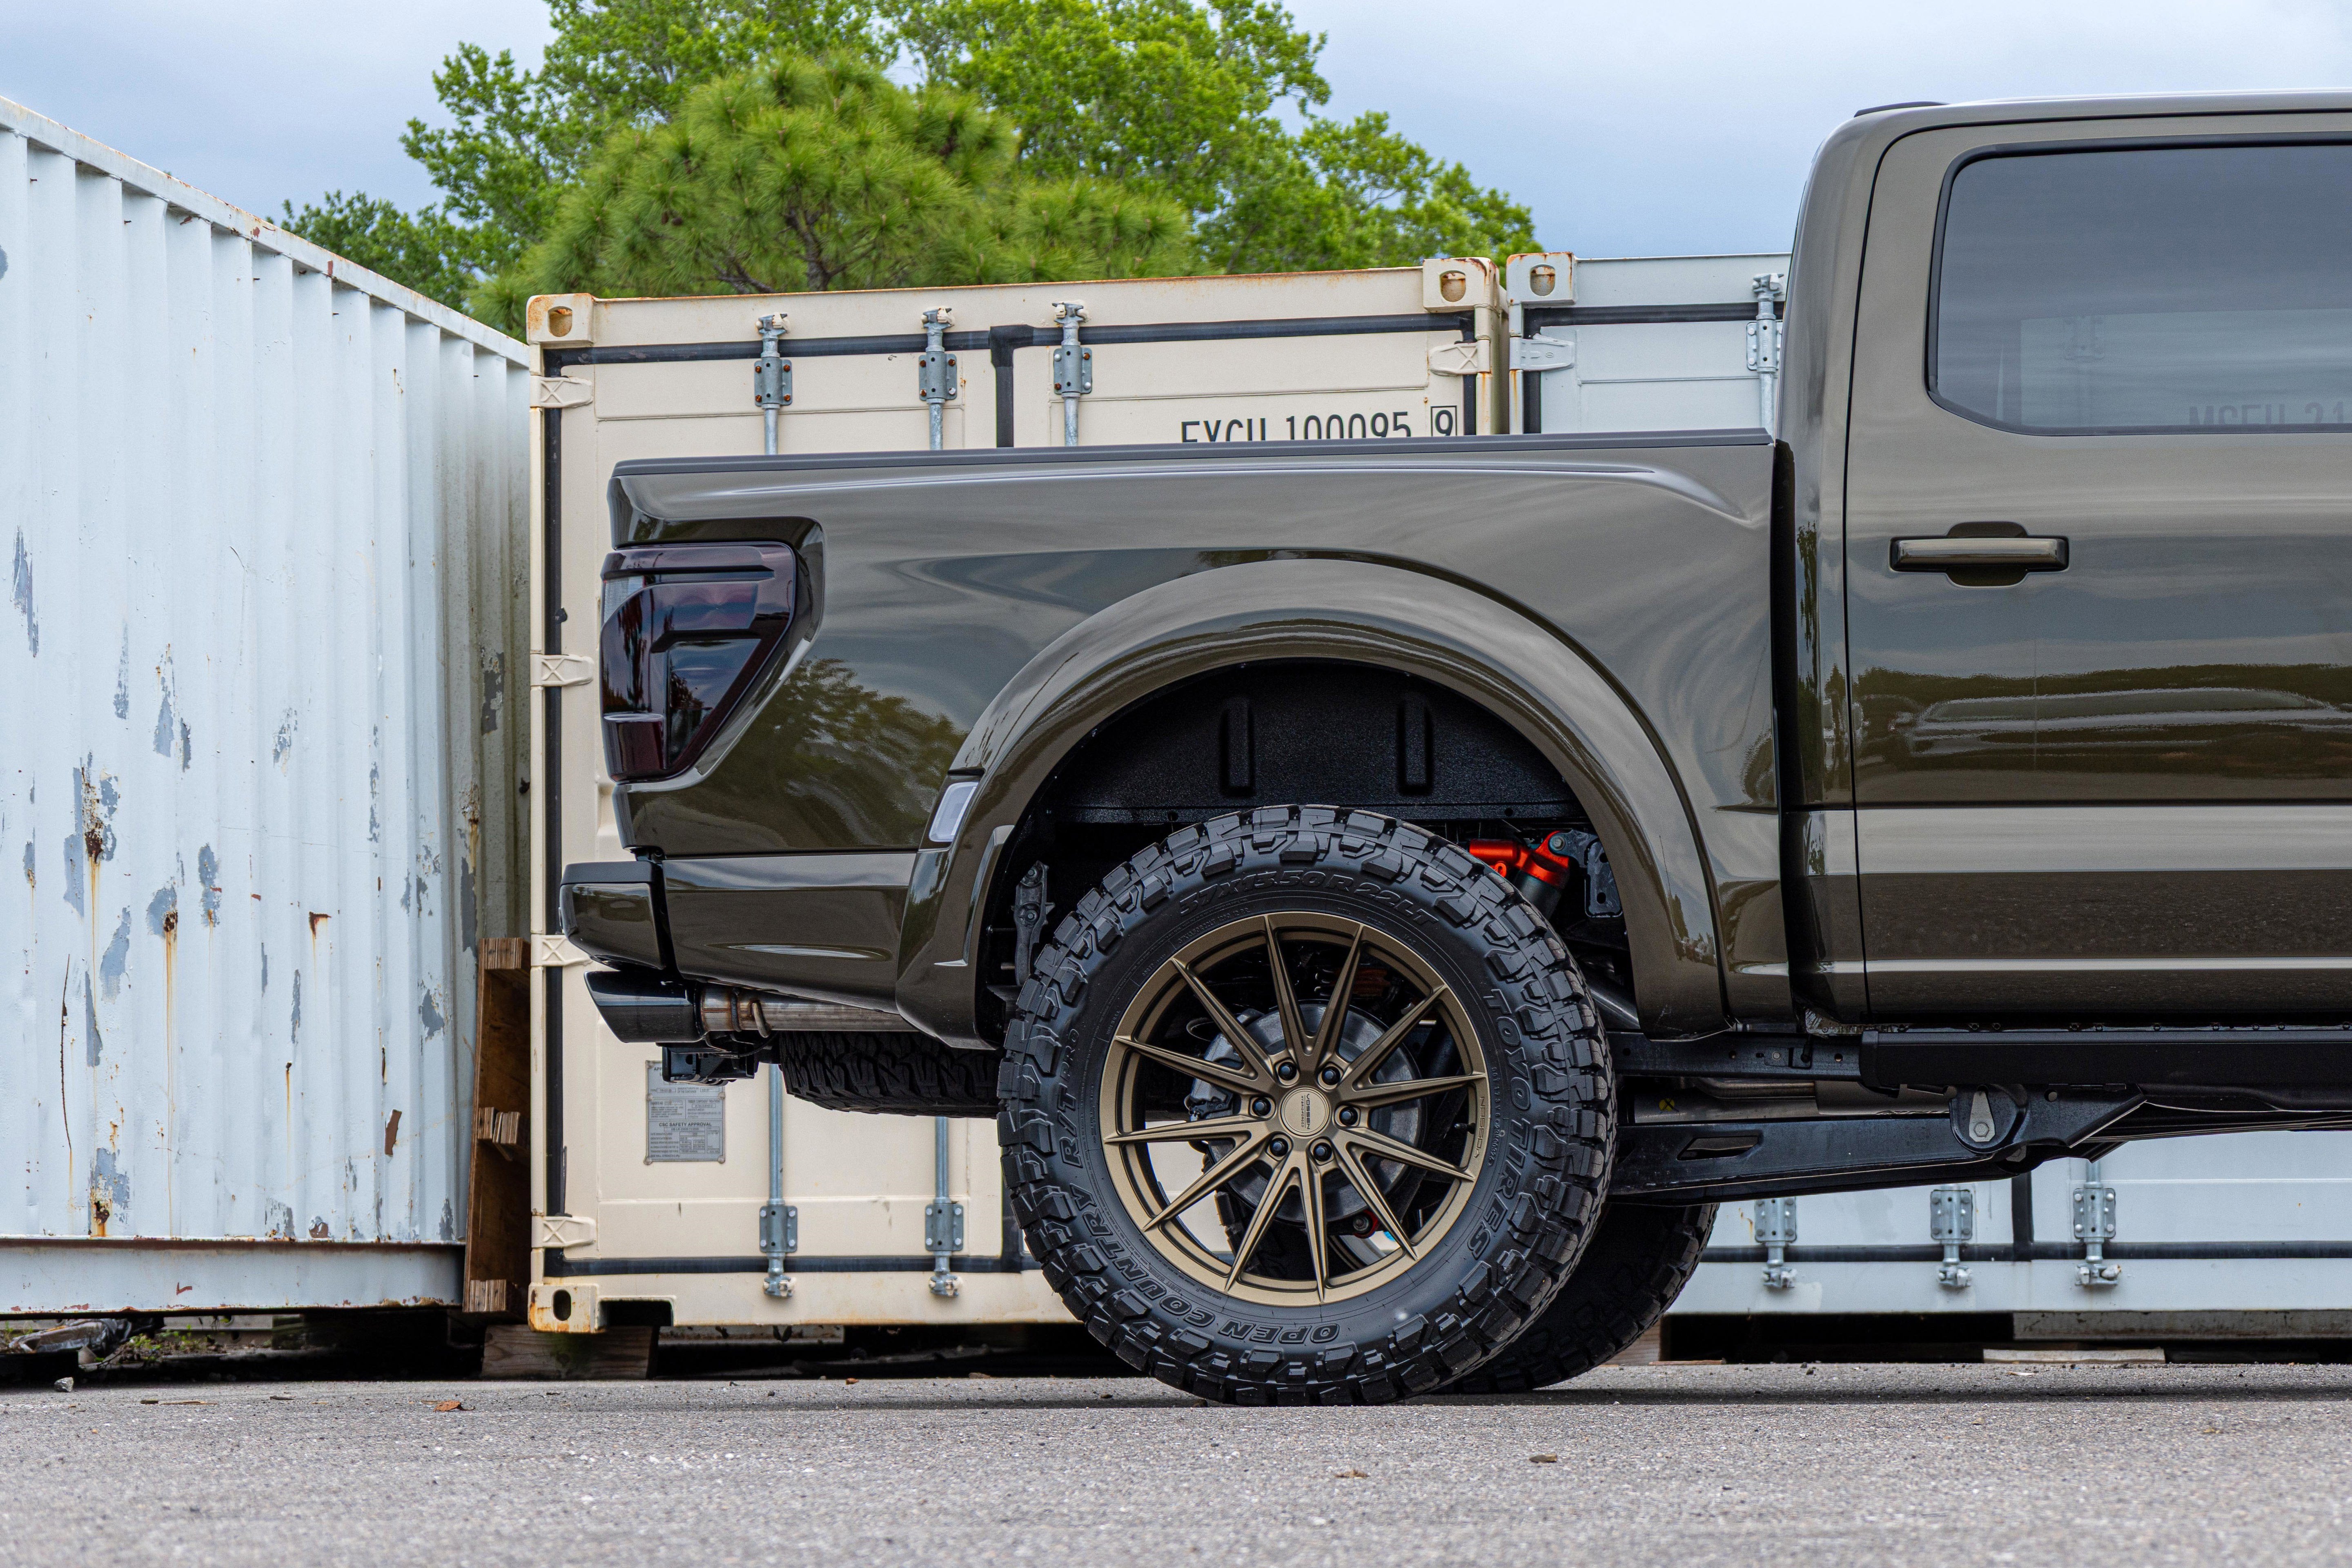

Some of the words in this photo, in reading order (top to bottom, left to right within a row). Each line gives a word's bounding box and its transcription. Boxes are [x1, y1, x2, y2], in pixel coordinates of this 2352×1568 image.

[1286, 412, 1411, 440] 100095
[1435, 410, 1453, 436] 9
[1483, 989, 1531, 1111] TOYO
[1057, 1082, 1083, 1168] R/T
[1474, 1096, 1486, 1158] VOSSEN
[1468, 1118, 1534, 1260] TIRES
[1069, 1183, 1216, 1327] COUNTRY
[1218, 1318, 1340, 1345] OPEN
